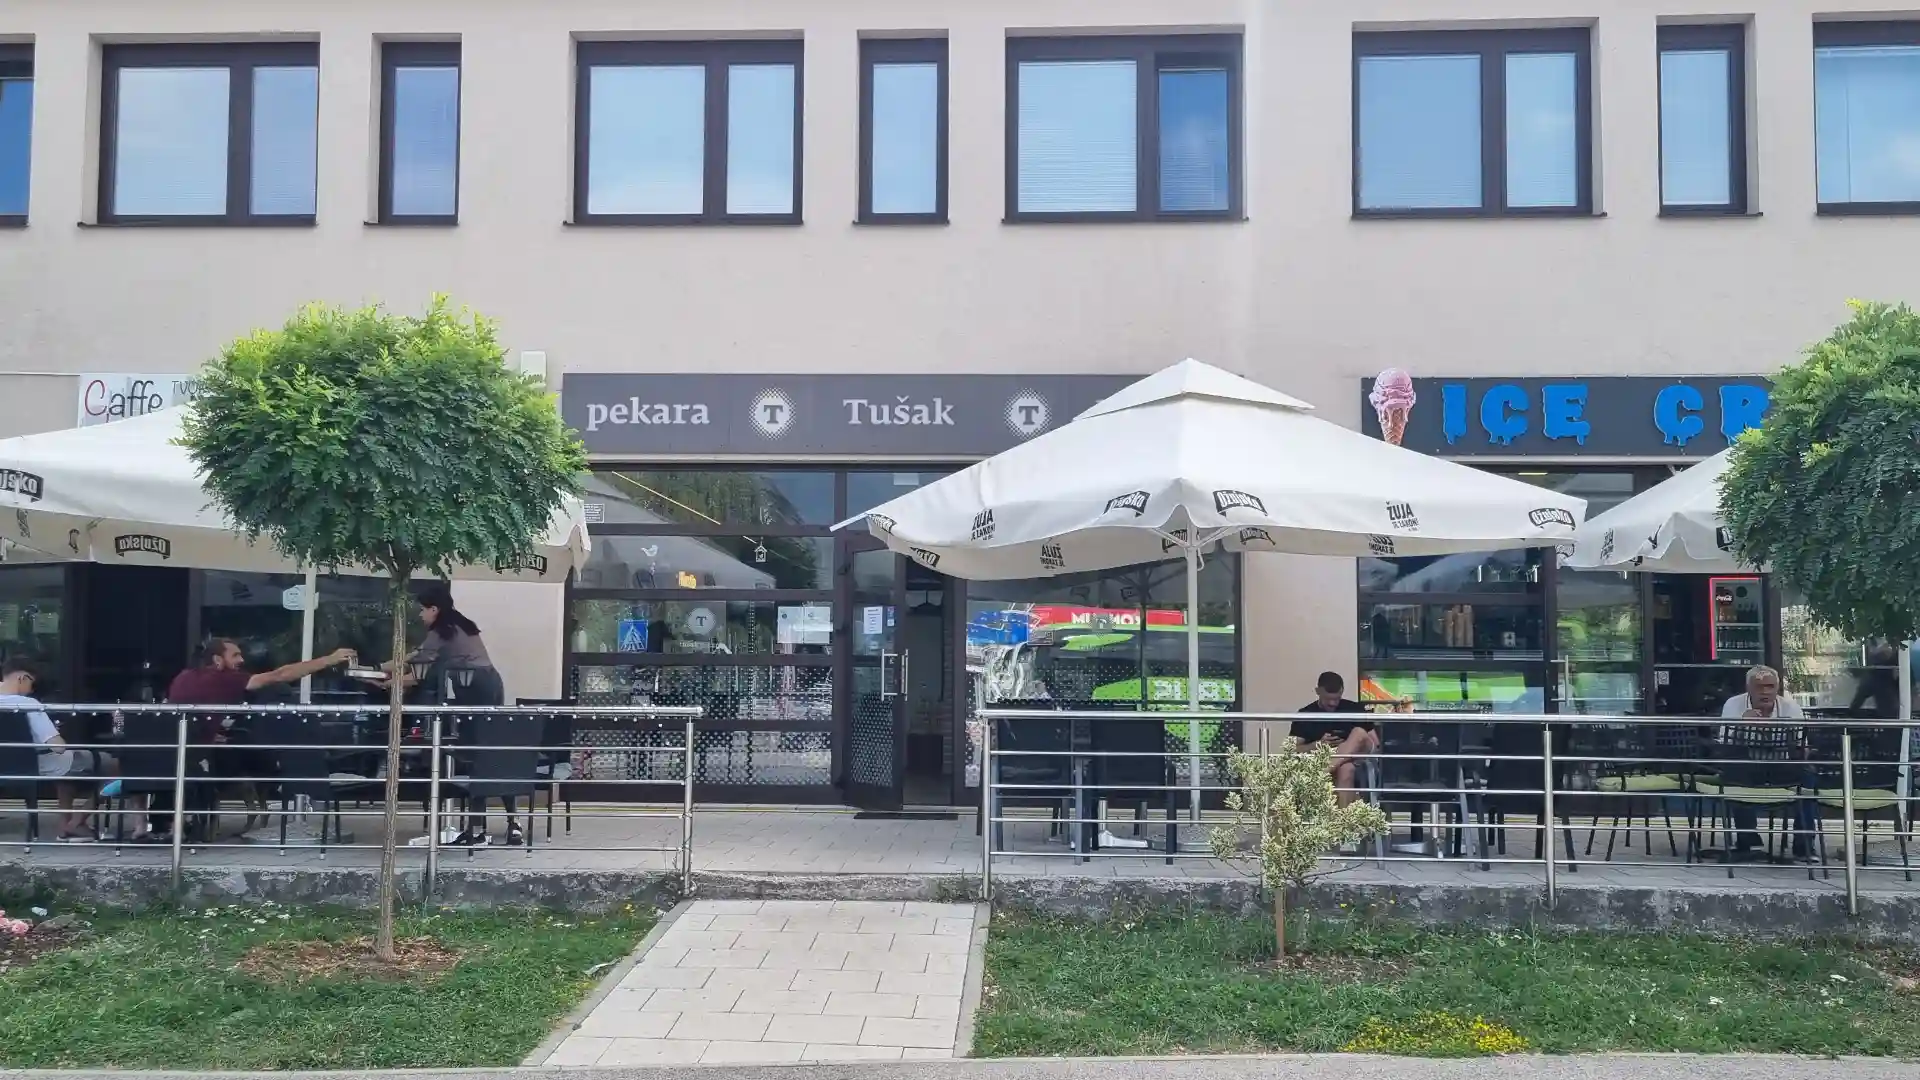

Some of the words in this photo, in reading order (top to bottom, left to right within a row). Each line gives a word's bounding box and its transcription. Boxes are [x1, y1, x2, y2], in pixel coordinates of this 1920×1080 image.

[586, 396, 710, 431] pekara
[763, 404, 784, 424] T
[843, 395, 955, 425] Tušak
[1018, 405, 1040, 425] T
[1442, 384, 1590, 445] ICE
[1386, 501, 1414, 520] ŽUJA
